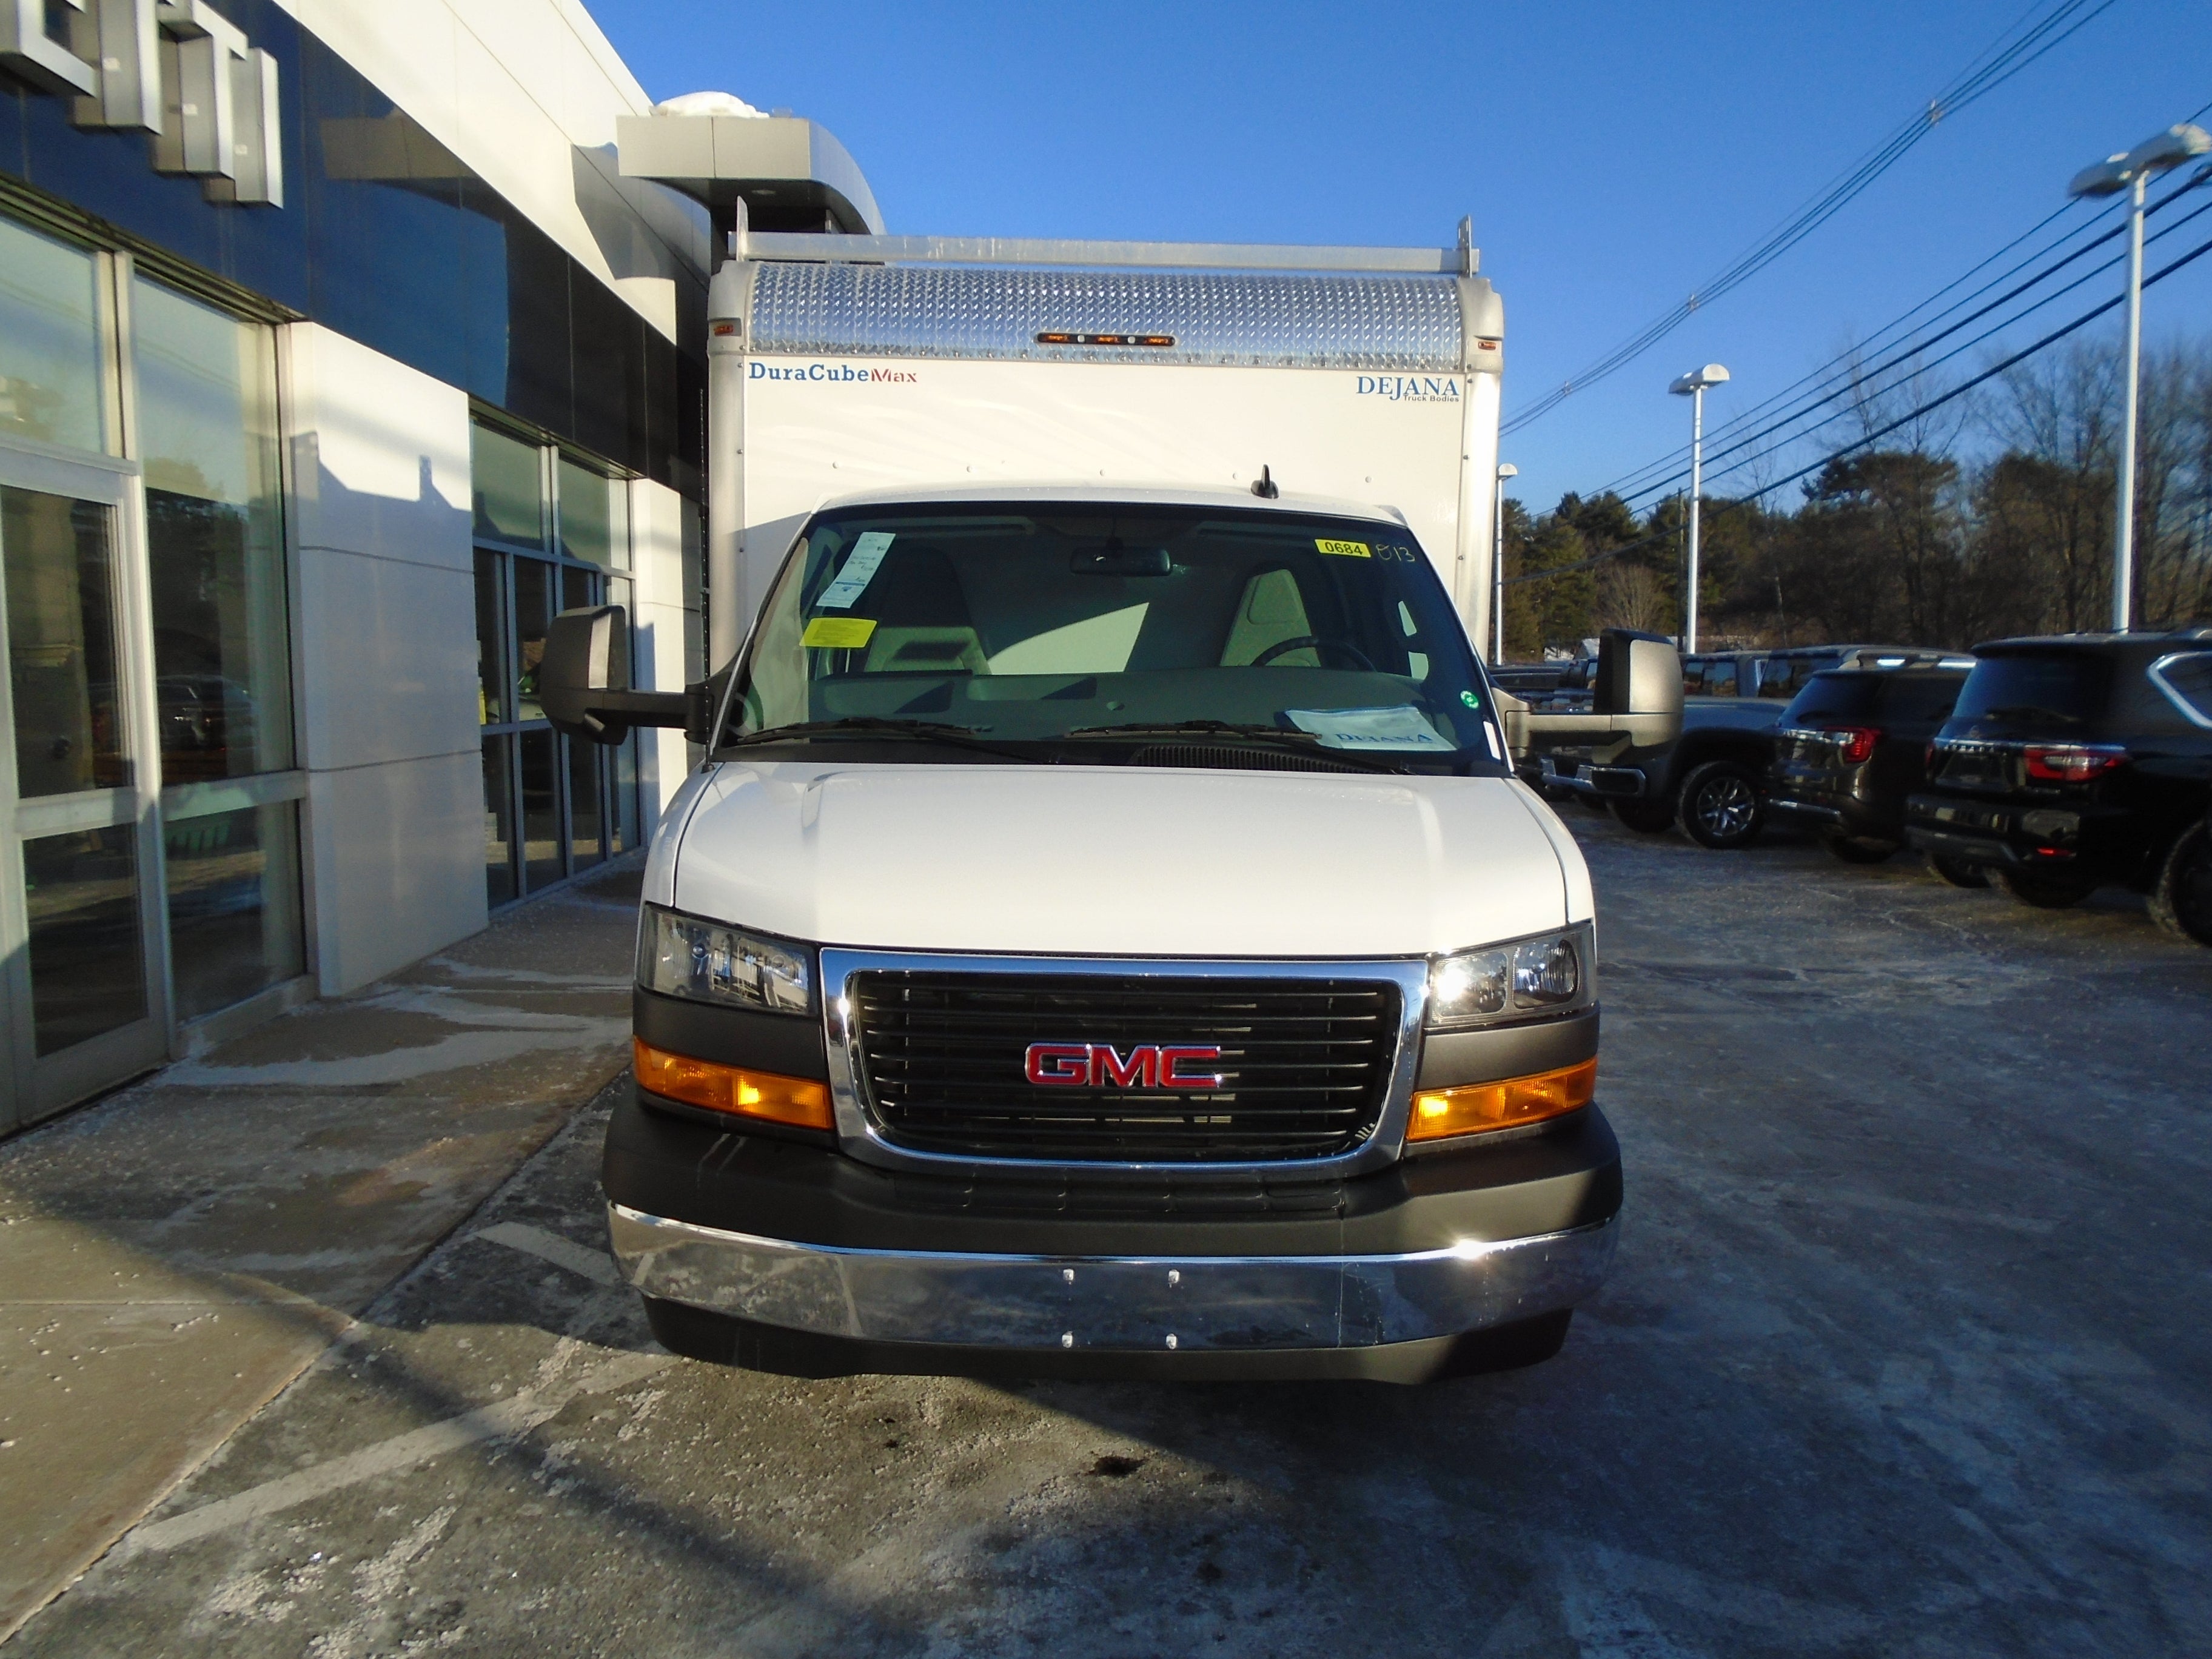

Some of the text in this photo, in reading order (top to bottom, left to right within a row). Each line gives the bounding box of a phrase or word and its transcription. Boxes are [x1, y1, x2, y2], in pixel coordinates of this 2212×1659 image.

[1356, 376, 1460, 400] DEJANA
[1324, 541, 1363, 555] 0684
[1025, 1042, 1222, 1087] GMC
